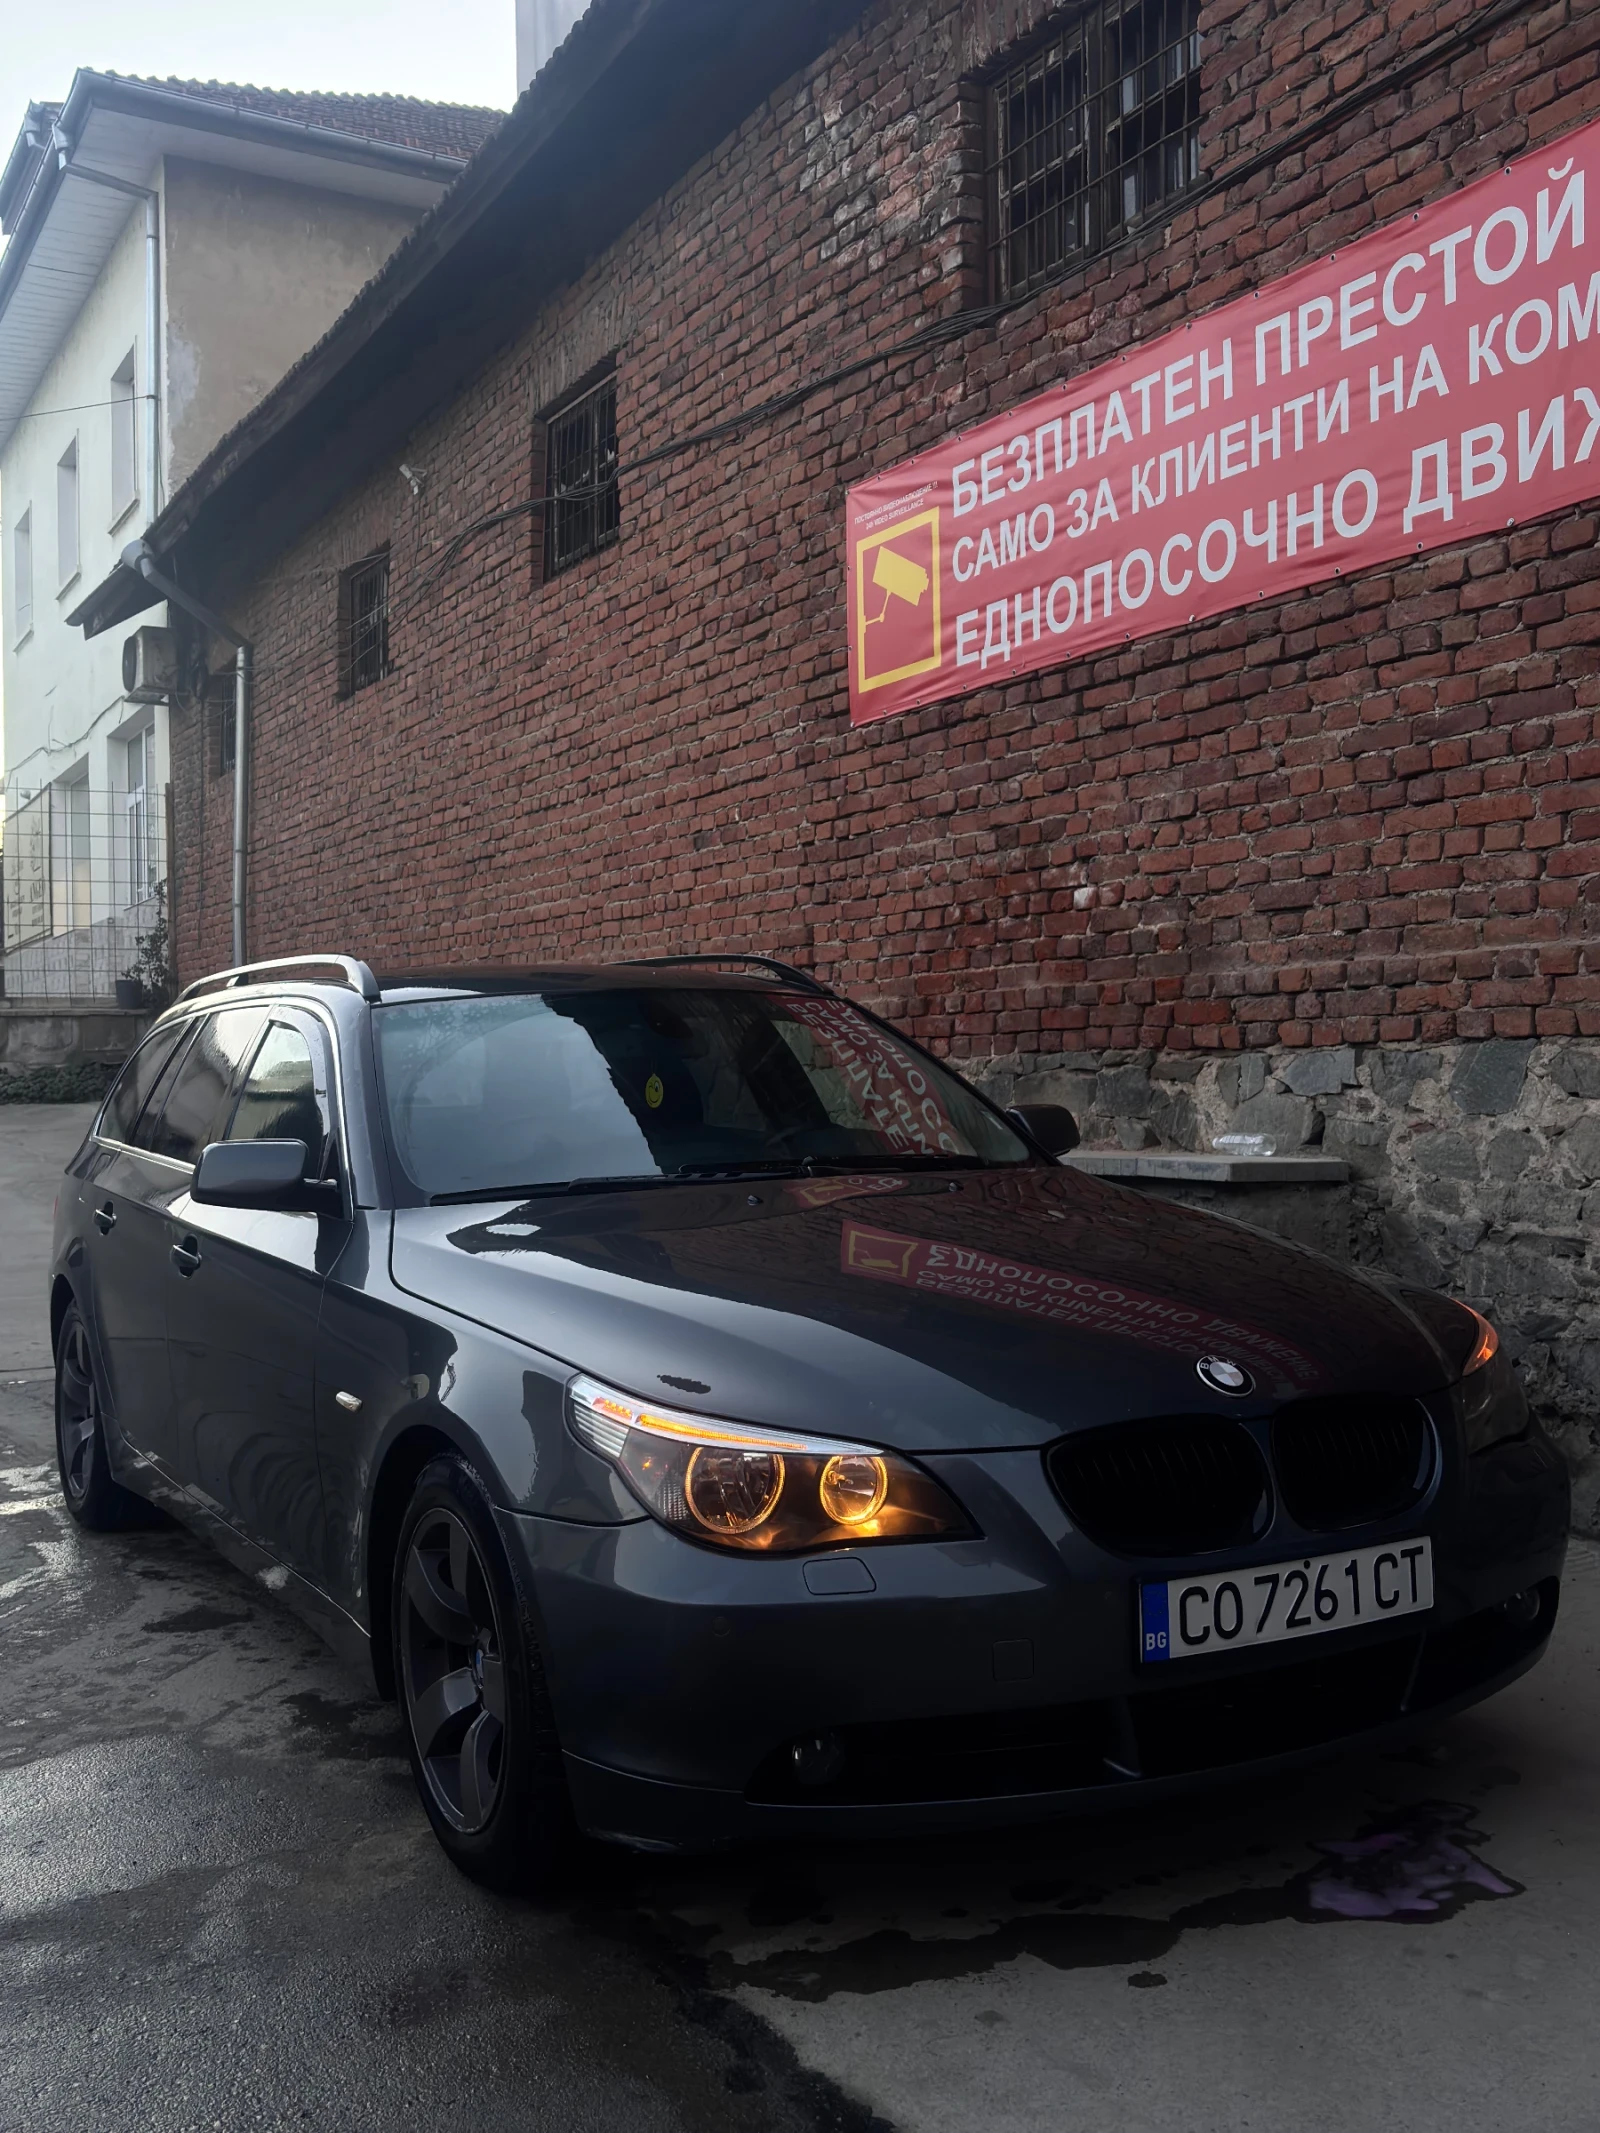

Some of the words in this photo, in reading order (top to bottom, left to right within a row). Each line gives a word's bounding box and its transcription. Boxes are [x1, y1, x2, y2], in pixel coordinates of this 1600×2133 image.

[952, 337, 1233, 518] БЕЗПЛАТЕН
[1255, 157, 1585, 386] ПРЕСТОЙ
[874, 514, 889, 526] VIDEO
[889, 498, 924, 520] SURVEILLANCE
[952, 503, 1055, 582] САМО
[1066, 477, 1119, 538] ЗА
[1131, 378, 1349, 515] КЛИЕНТИ
[1369, 343, 1450, 423] НА
[956, 469, 1378, 669] ЕДНОПОСОЧНО
[1199, 1355, 1237, 1370] BMW
[1146, 1632, 1167, 1651] BG
